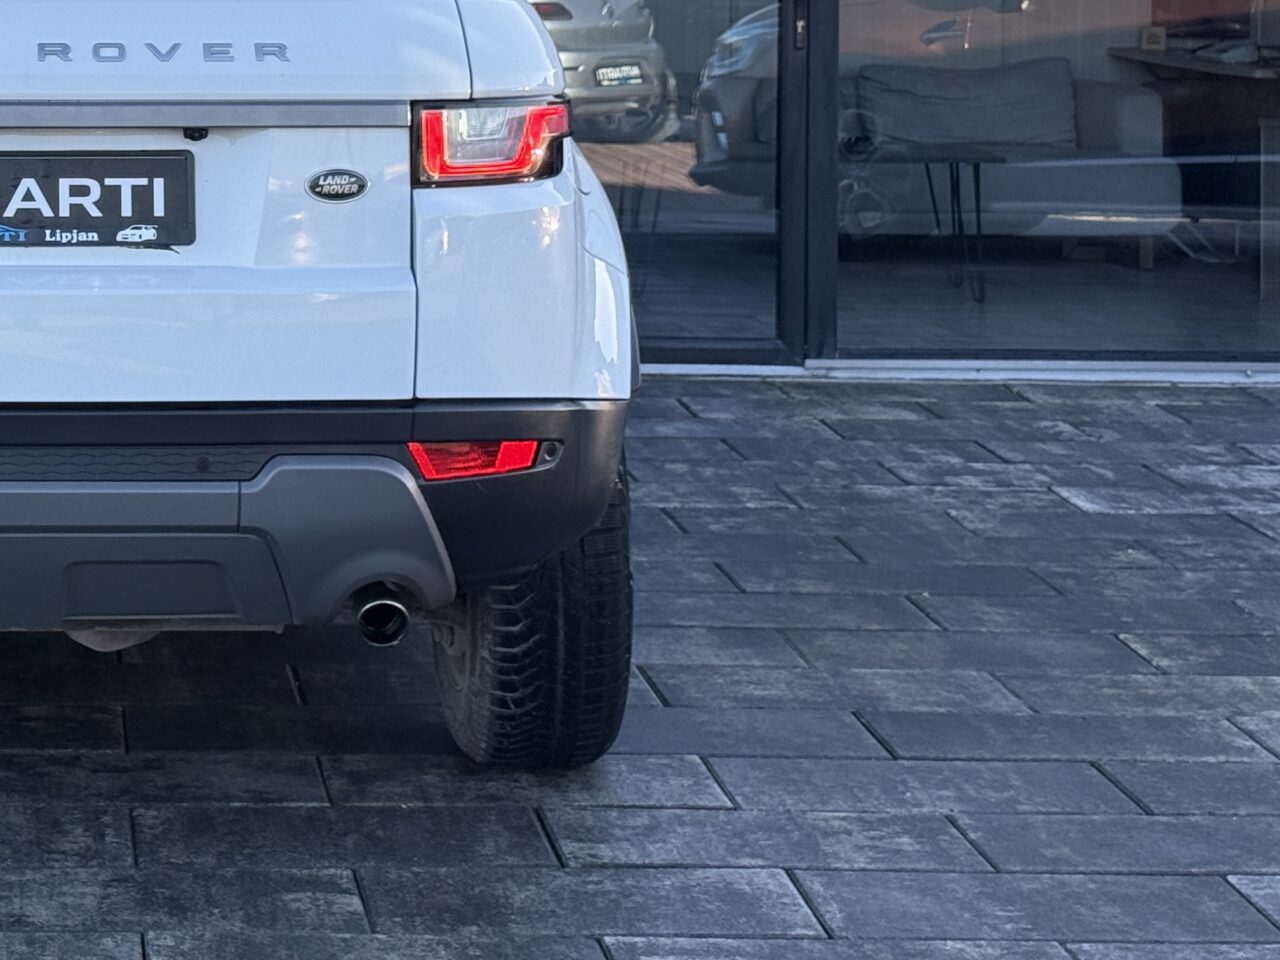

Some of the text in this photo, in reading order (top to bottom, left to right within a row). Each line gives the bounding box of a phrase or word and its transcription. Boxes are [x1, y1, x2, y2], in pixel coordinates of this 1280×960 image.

[37, 42, 290, 62] ROVER
[319, 175, 349, 185] LAND
[321, 184, 359, 194] ROVER
[3, 177, 165, 218] ARTI
[44, 229, 99, 244] Lipjan
